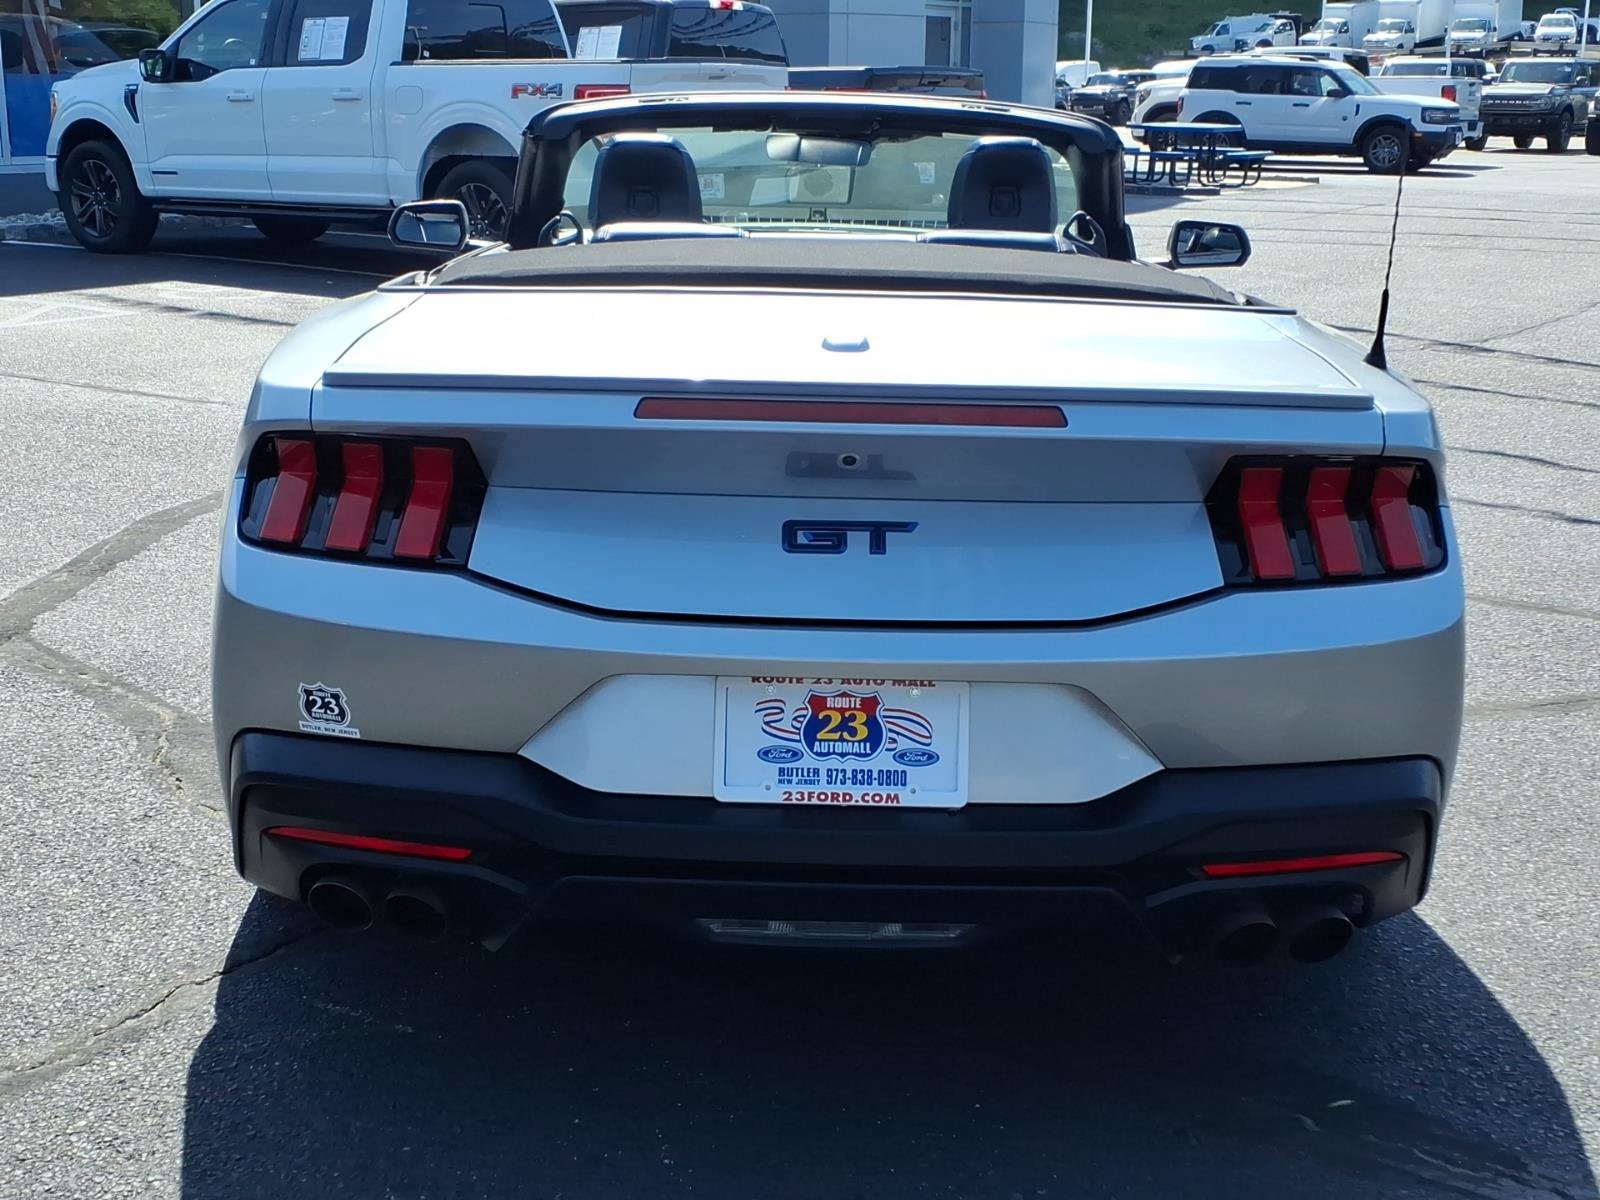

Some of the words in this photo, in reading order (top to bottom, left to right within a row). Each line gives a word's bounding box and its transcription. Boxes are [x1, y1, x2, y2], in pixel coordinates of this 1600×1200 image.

[511, 83, 563, 99] FX4
[782, 519, 919, 556] GT
[309, 696, 339, 715] 23
[826, 697, 862, 709] ROUTE
[816, 710, 869, 741] 23
[767, 749, 793, 759] Ford
[813, 742, 871, 754] AUTOMALL
[903, 751, 929, 762] Ford
[778, 767, 820, 778] BUTLER
[826, 768, 907, 787] 973-838-0800
[795, 778, 821, 786] JERSEY
[782, 790, 900, 804] 23FORD.COM
